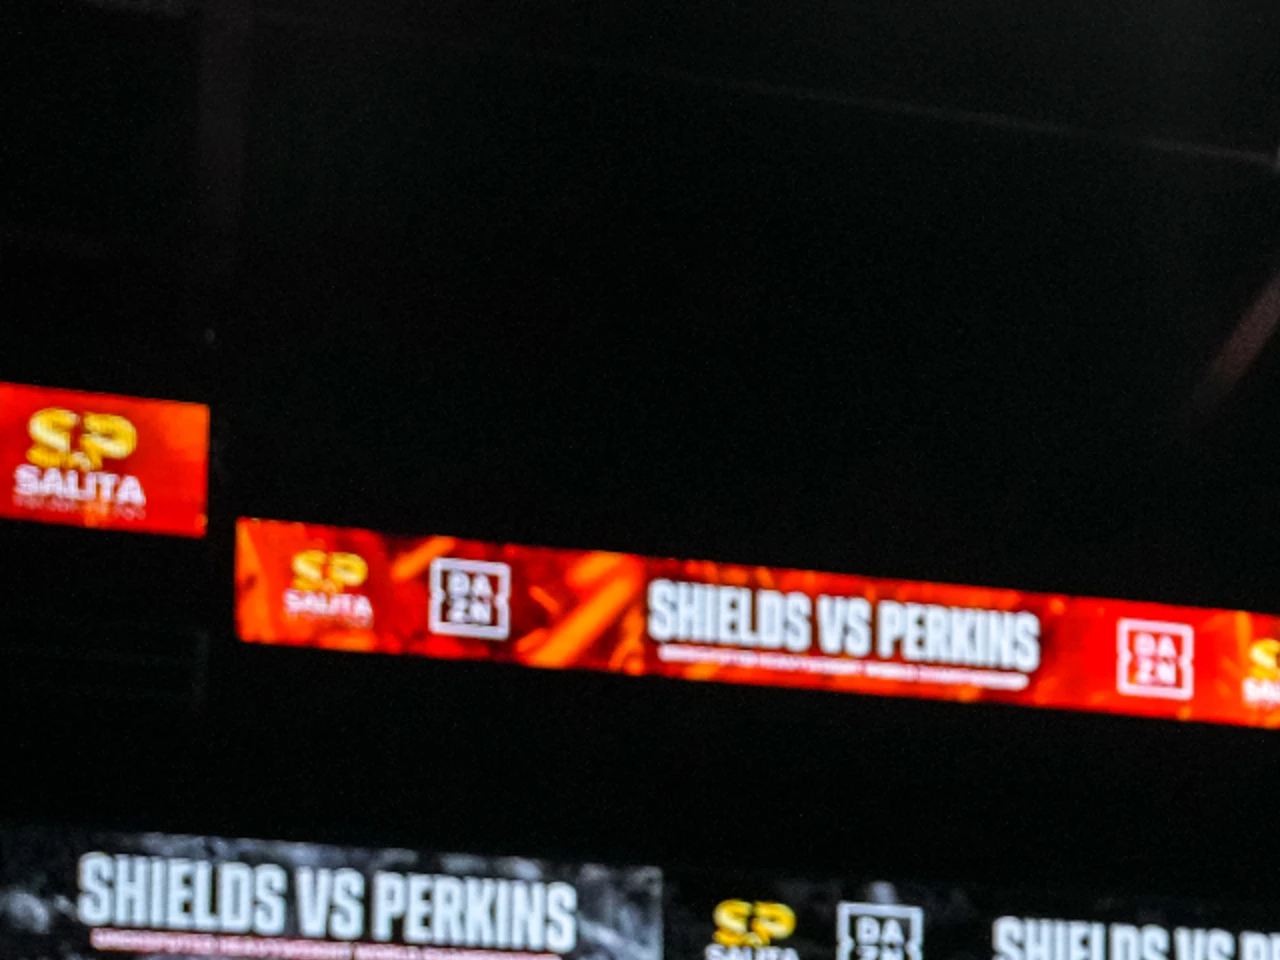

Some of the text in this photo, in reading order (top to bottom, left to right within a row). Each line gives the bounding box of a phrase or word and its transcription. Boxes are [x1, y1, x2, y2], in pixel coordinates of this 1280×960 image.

[27, 407, 137, 469] SP
[14, 464, 146, 506] SALITA
[291, 550, 368, 592] SP
[284, 588, 373, 618] SALITA
[647, 578, 811, 652] SHIELDS
[818, 595, 872, 657] VS
[877, 601, 1041, 674] PERKINS
[78, 852, 287, 936] SHIELDS
[295, 866, 364, 940] VS
[373, 871, 578, 953] PERKINS
[713, 899, 796, 947] SP
